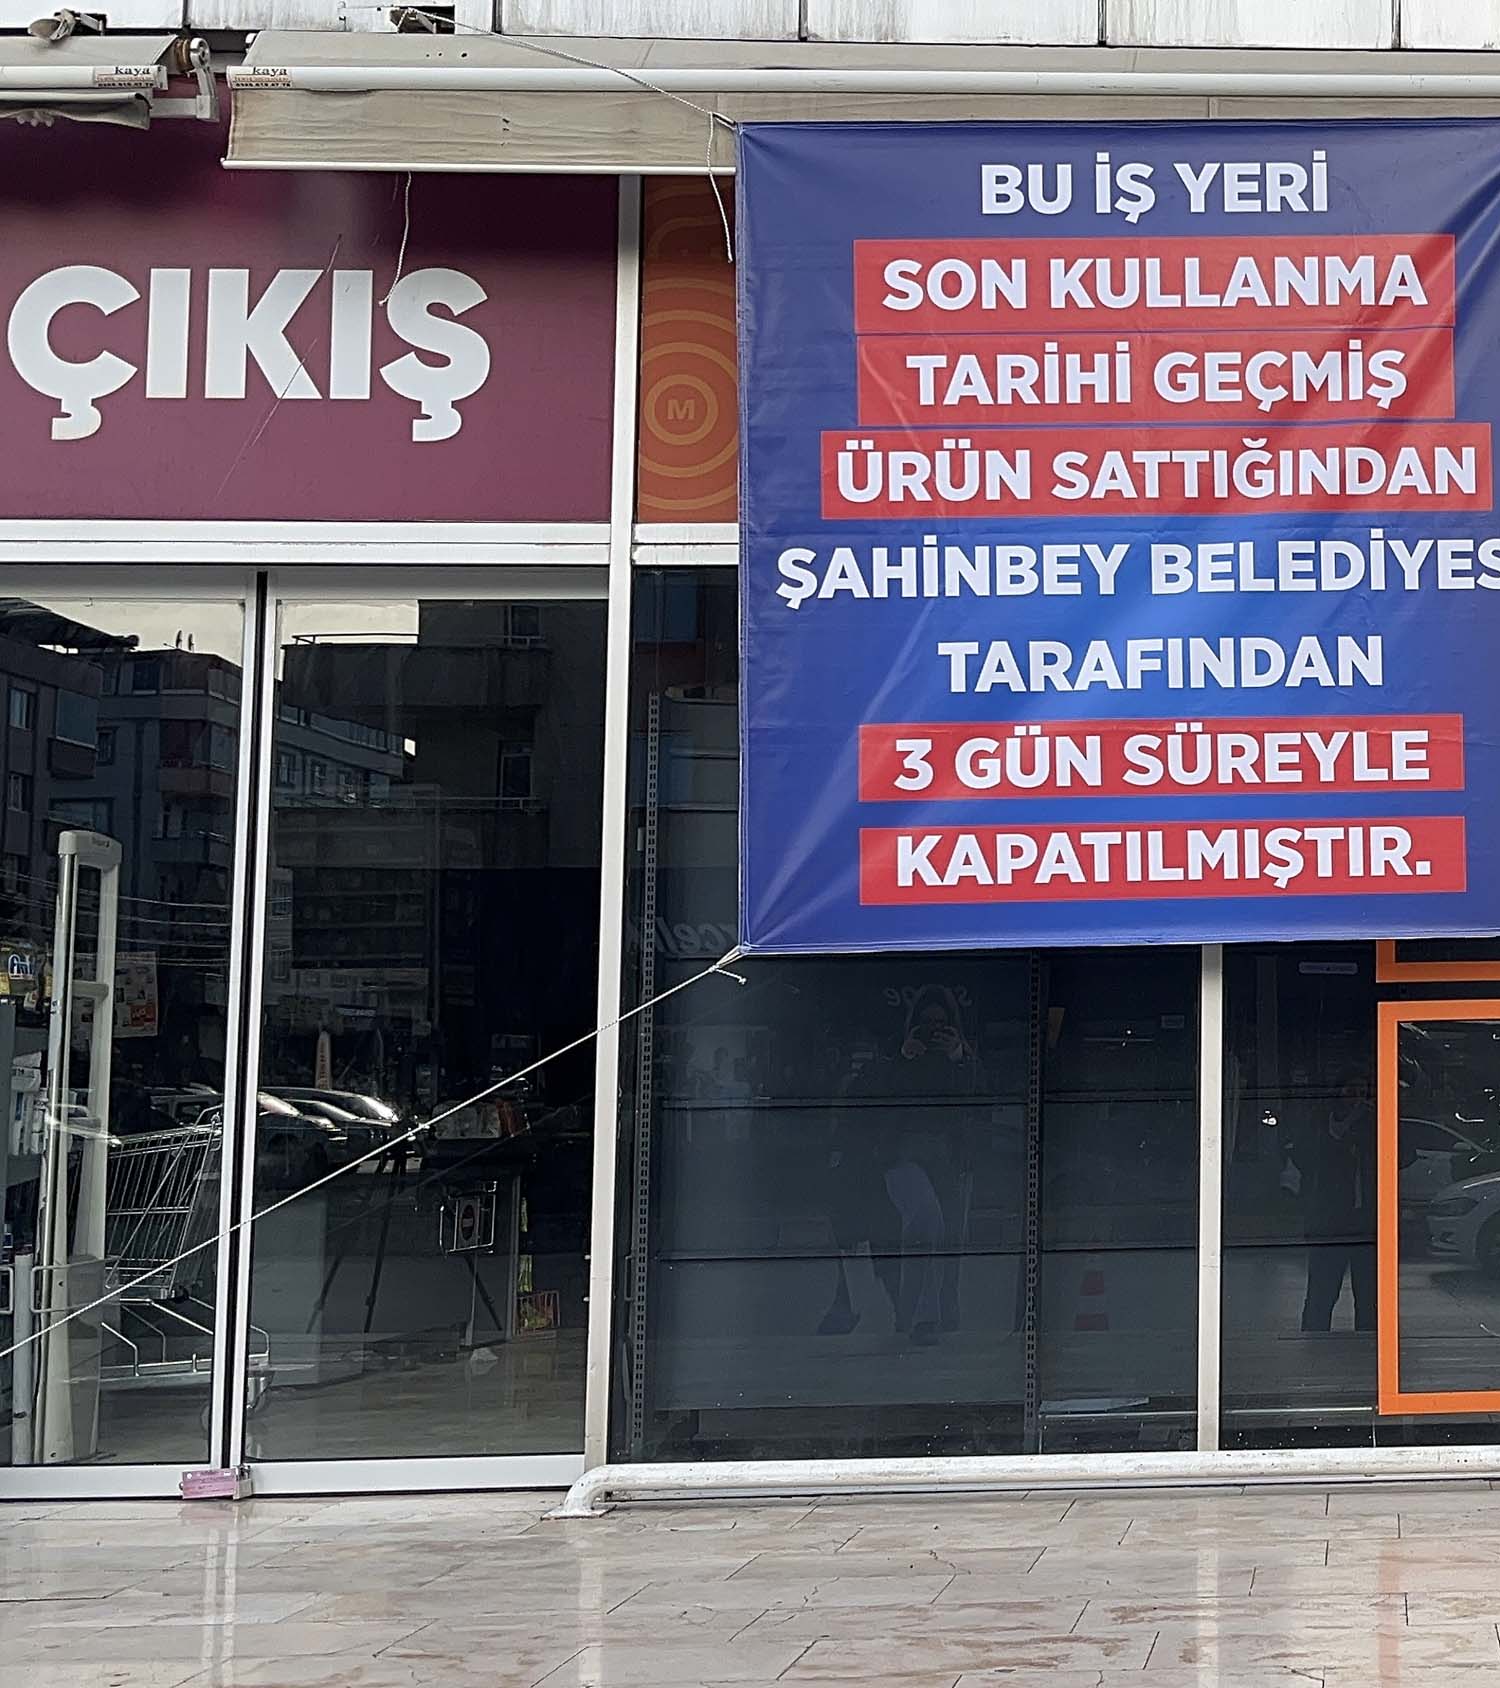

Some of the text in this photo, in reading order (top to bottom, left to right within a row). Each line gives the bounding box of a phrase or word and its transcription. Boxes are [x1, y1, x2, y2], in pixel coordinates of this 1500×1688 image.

[114, 66, 150, 76] kaya
[253, 66, 287, 77] kaya
[982, 151, 1328, 223] BU İŞ YERİ
[883, 255, 1428, 310] SON KULLANMA
[7, 265, 490, 442] ÇIKIŞ
[906, 340, 1406, 412] TARİHİ GEÇMİŞ
[838, 438, 1475, 502] ÜRÜN SATTIĞINDAN
[776, 535, 1129, 609] ŞAHİNBEY
[938, 636, 1382, 692] TARAFINDAN
[894, 723, 1429, 790] 3 GÜN SÜREYLE
[898, 827, 1430, 888] KAPATILMIŞTIR.
